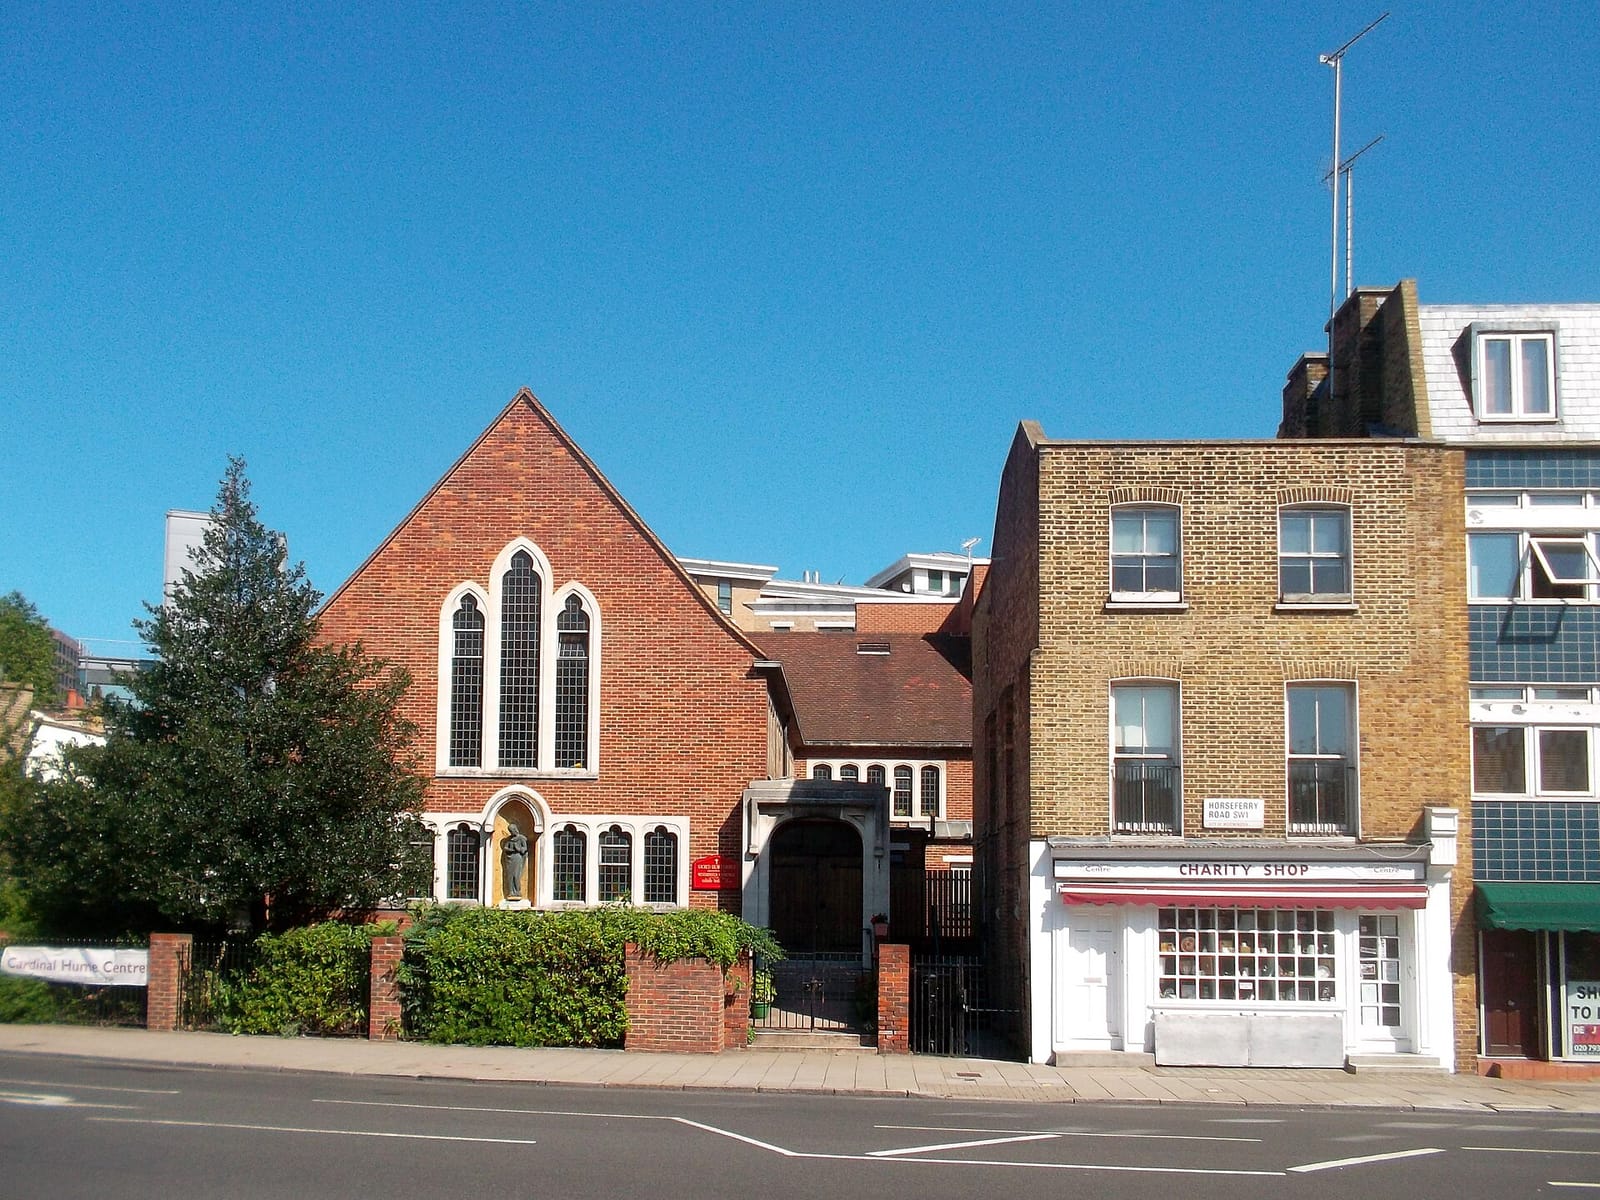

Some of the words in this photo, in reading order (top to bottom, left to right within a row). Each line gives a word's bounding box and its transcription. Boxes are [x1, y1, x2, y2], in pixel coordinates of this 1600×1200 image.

[1208, 801, 1259, 810] HORSEFERRY
[1208, 810, 1230, 819] ROAD
[1233, 811, 1249, 819] SW1
[1179, 863, 1252, 876] CHARITY
[1263, 864, 1309, 876] SHOP
[7, 957, 56, 971] Cardinal
[61, 960, 98, 973] Hume
[103, 961, 146, 974] Centre
[1571, 1006, 1591, 1019] TO
